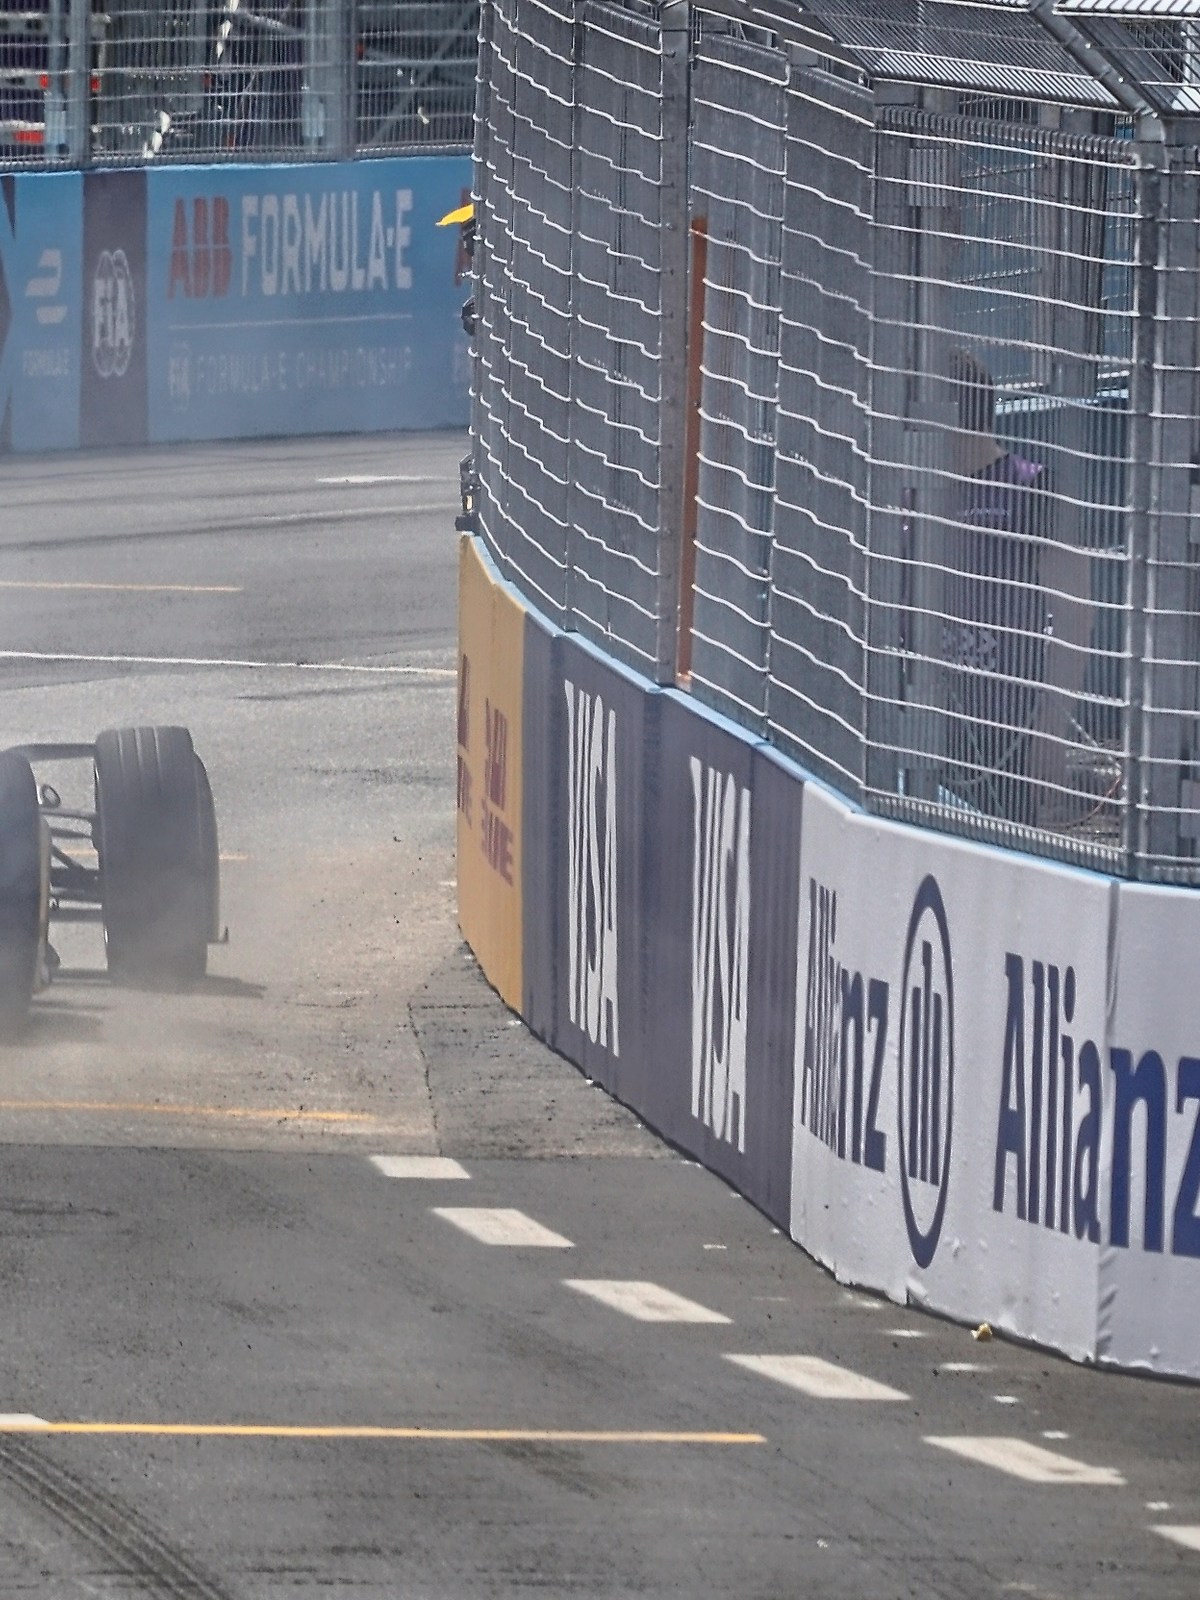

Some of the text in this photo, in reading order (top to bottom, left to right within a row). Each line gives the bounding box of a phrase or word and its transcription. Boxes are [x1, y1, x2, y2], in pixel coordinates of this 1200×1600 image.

[94, 278, 132, 348] FIA
[168, 196, 232, 298] ABB
[564, 679, 620, 1057] VISA
[689, 756, 752, 1154] VISA
[801, 876, 889, 1173] Allianz
